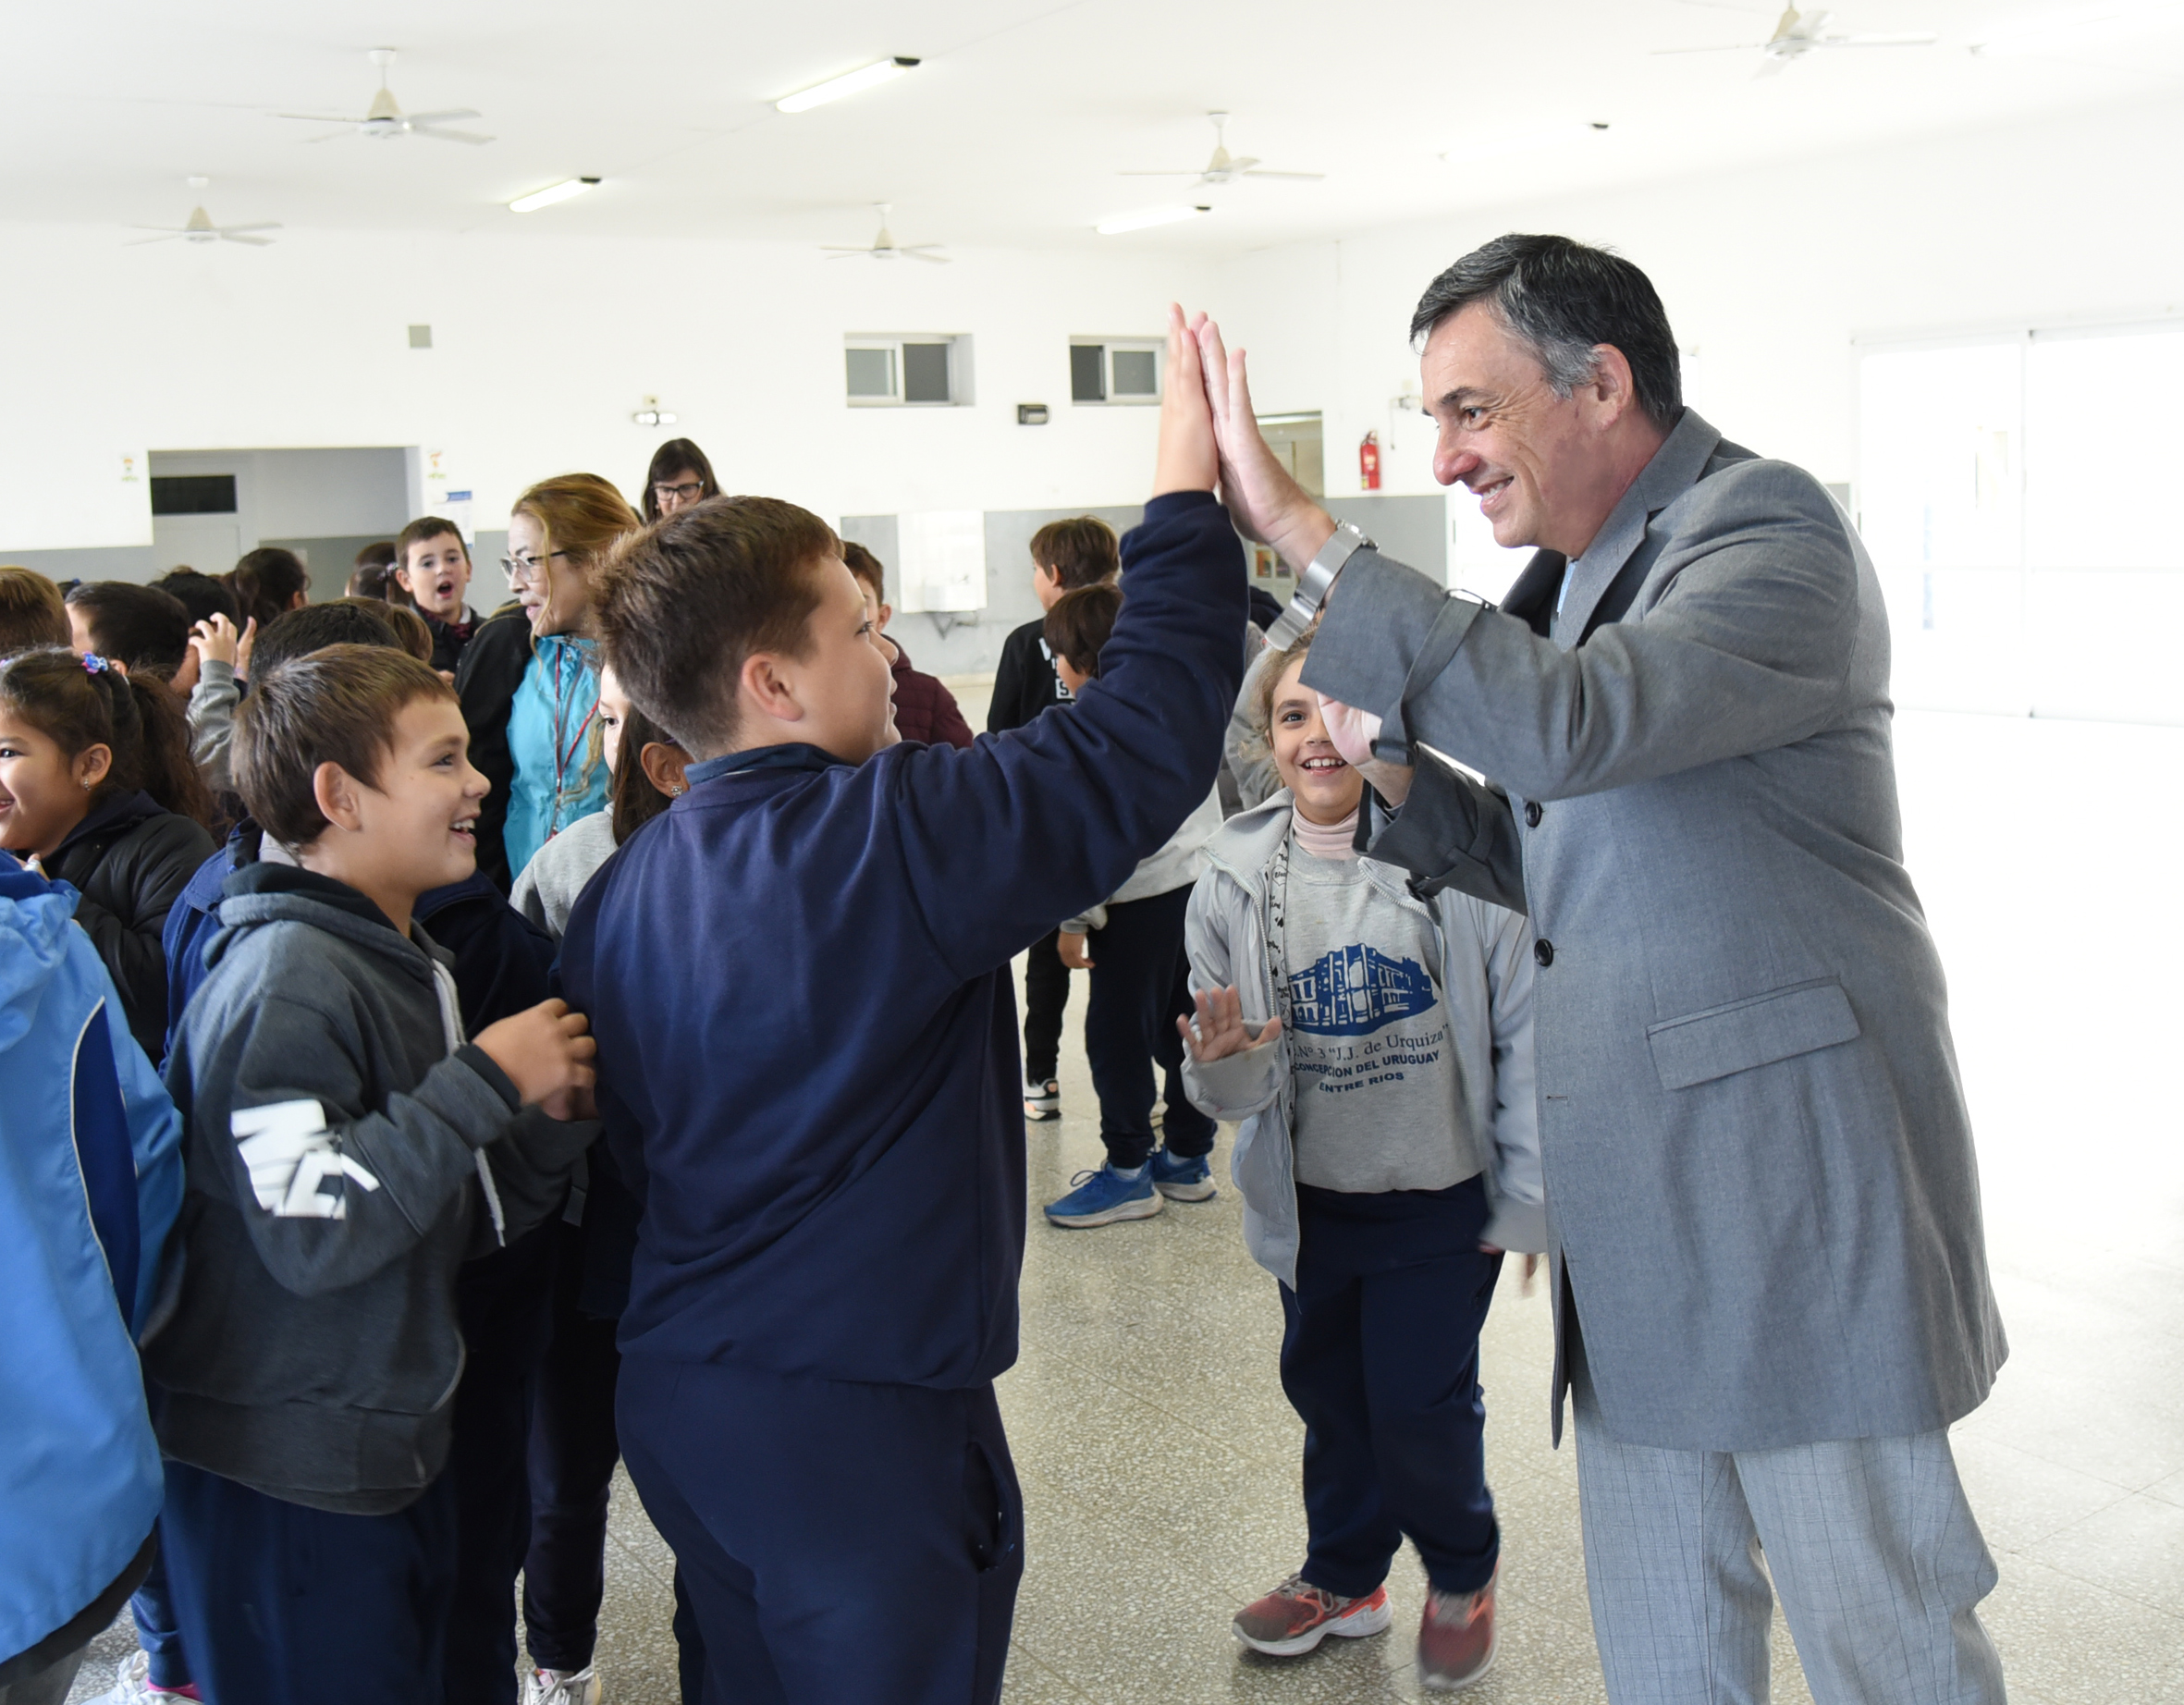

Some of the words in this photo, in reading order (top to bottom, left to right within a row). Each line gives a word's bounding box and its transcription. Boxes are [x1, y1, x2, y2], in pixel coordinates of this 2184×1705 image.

[1317, 1047, 1327, 1060] 3
[1364, 1040, 1382, 1056] de
[1294, 1061, 1353, 1079] CONCEPCION
[1356, 1060, 1380, 1073] DEL
[1382, 1049, 1440, 1066] URUGUAY
[1319, 1080, 1365, 1094] ENTRE
[1368, 1072, 1405, 1086] RIOS
